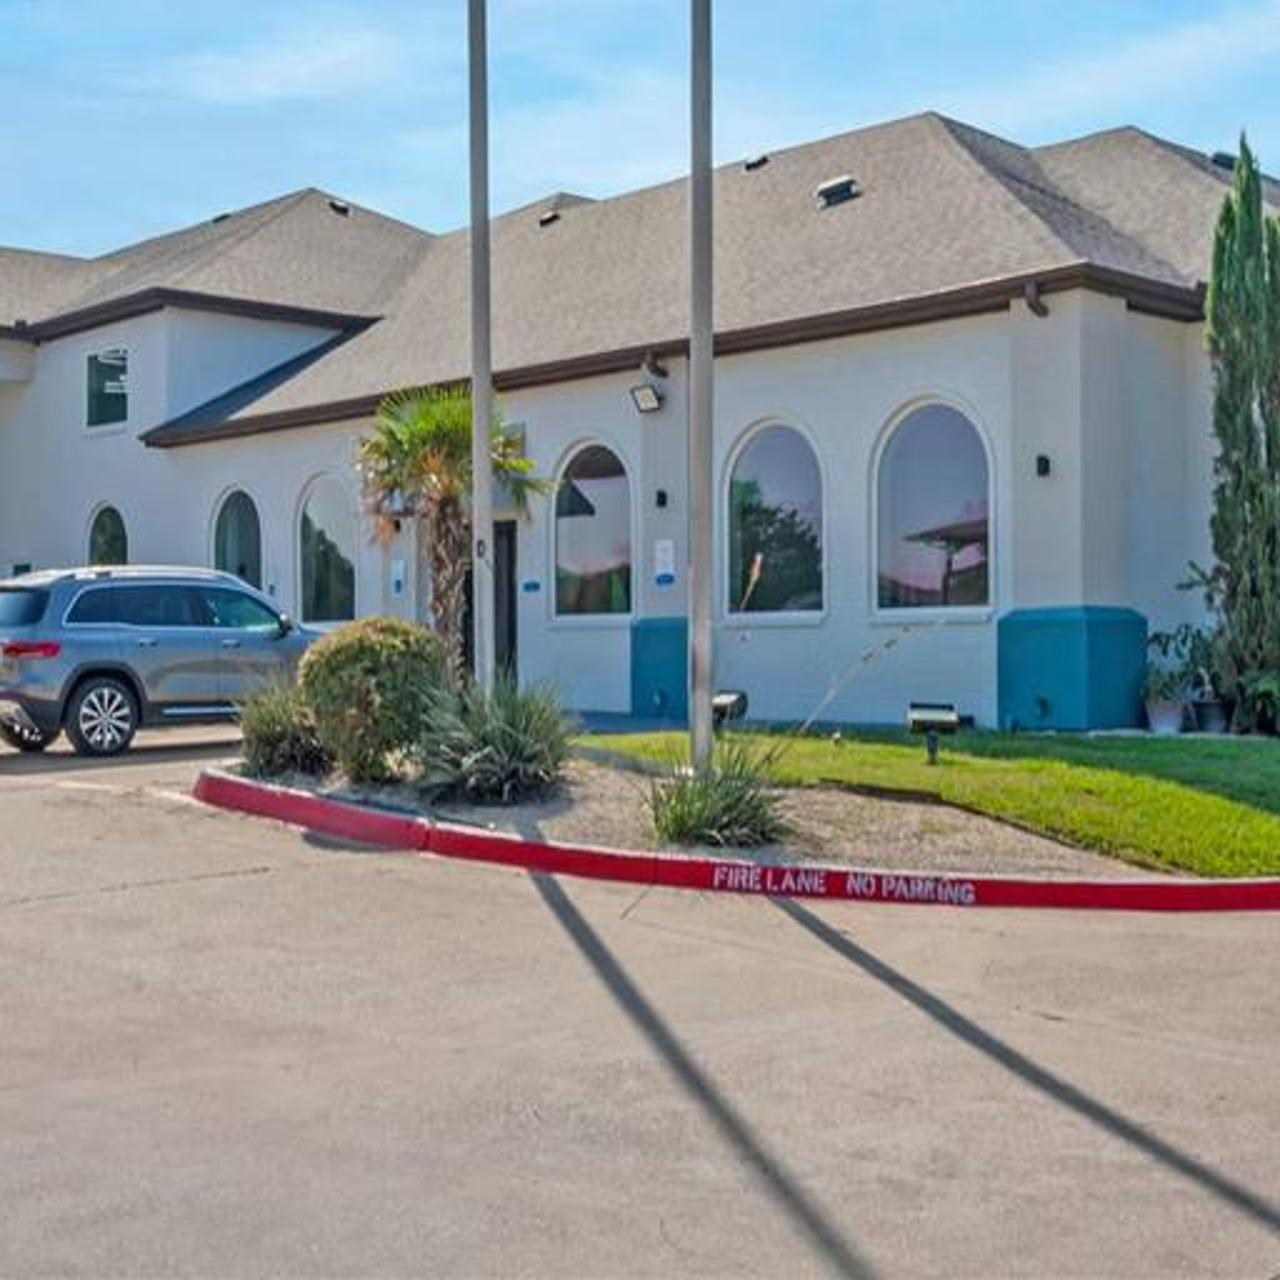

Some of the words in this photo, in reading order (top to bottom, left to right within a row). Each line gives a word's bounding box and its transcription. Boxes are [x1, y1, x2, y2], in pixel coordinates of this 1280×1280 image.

[712, 866, 761, 892] FIRE
[767, 869, 827, 893] LANE
[846, 872, 876, 895] NO
[881, 875, 975, 904] PARKING
